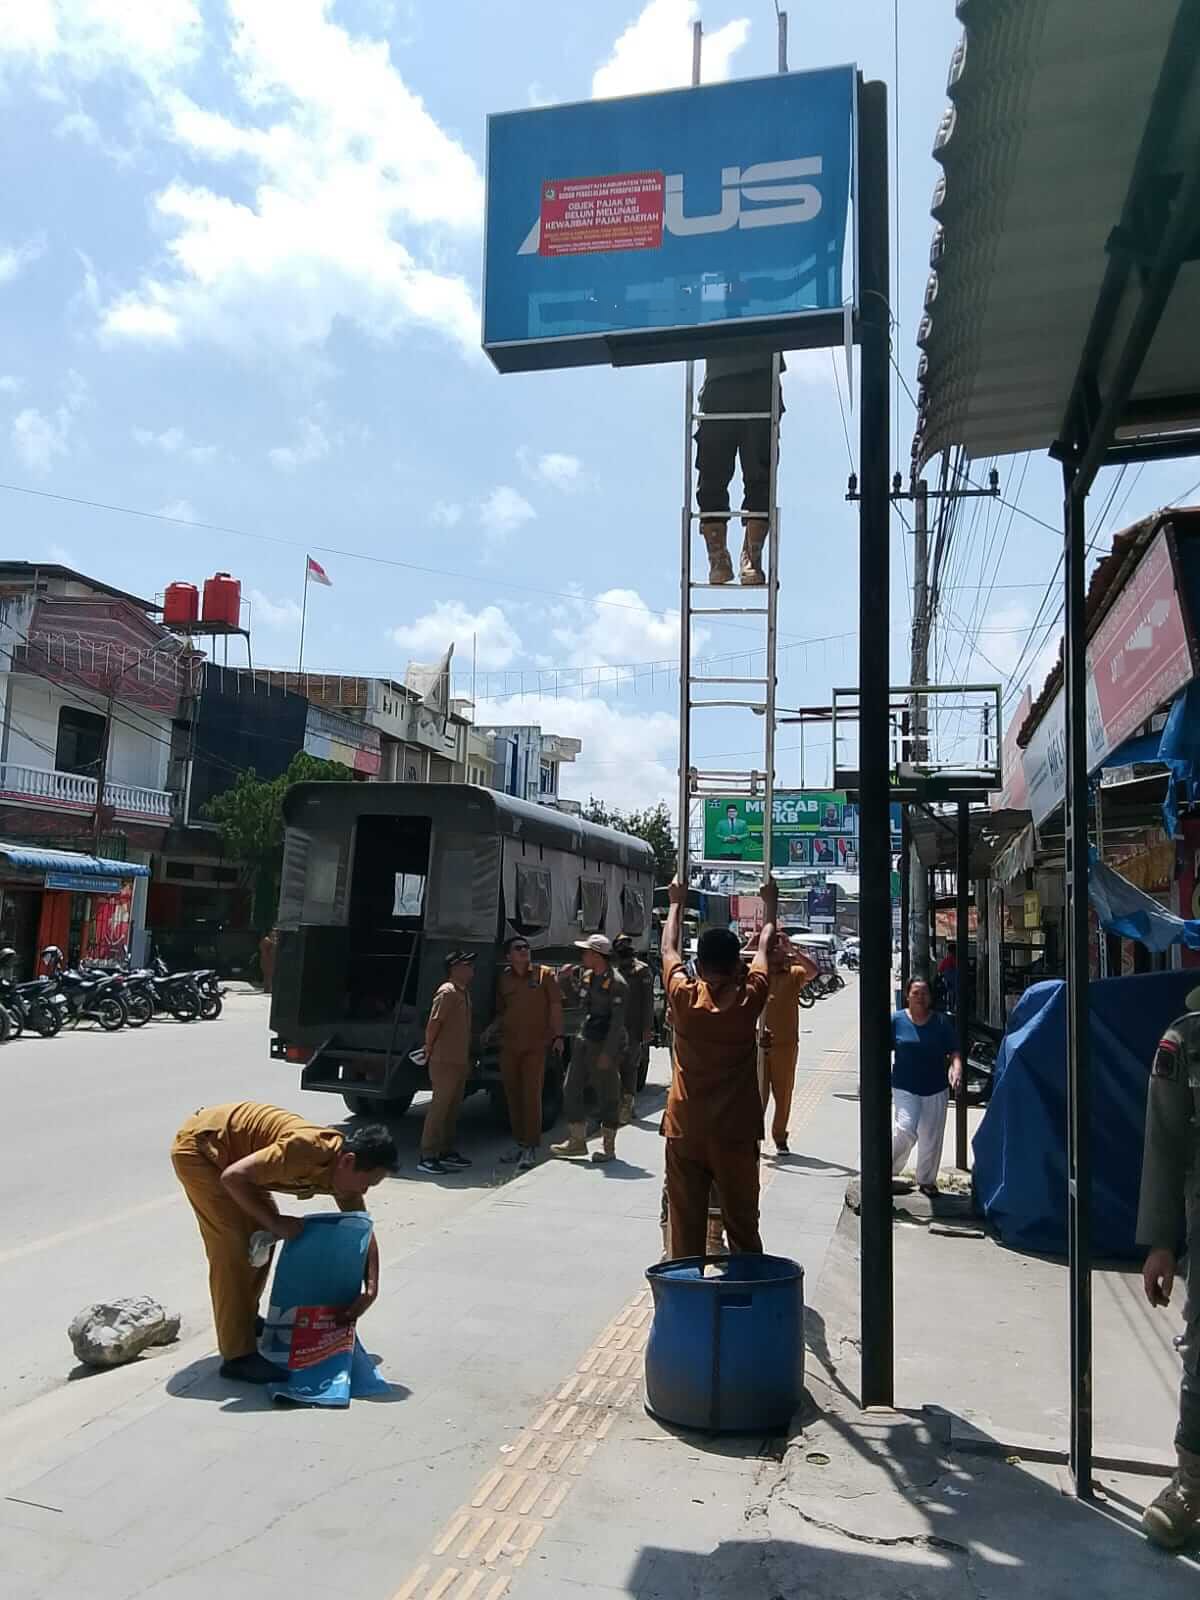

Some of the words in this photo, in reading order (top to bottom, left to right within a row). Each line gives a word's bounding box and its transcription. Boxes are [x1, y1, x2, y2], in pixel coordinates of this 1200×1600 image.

[568, 199, 595, 211] OBJEK
[596, 198, 623, 209] PAJAK
[625, 197, 637, 206] INI
[565, 209, 594, 220] BELUM
[596, 205, 640, 218] MELUNASI
[545, 217, 593, 230] KEWAJIBAN
[595, 215, 622, 226] PAJAK
[624, 212, 659, 223] DAERAH
[772, 811, 799, 824] KB
